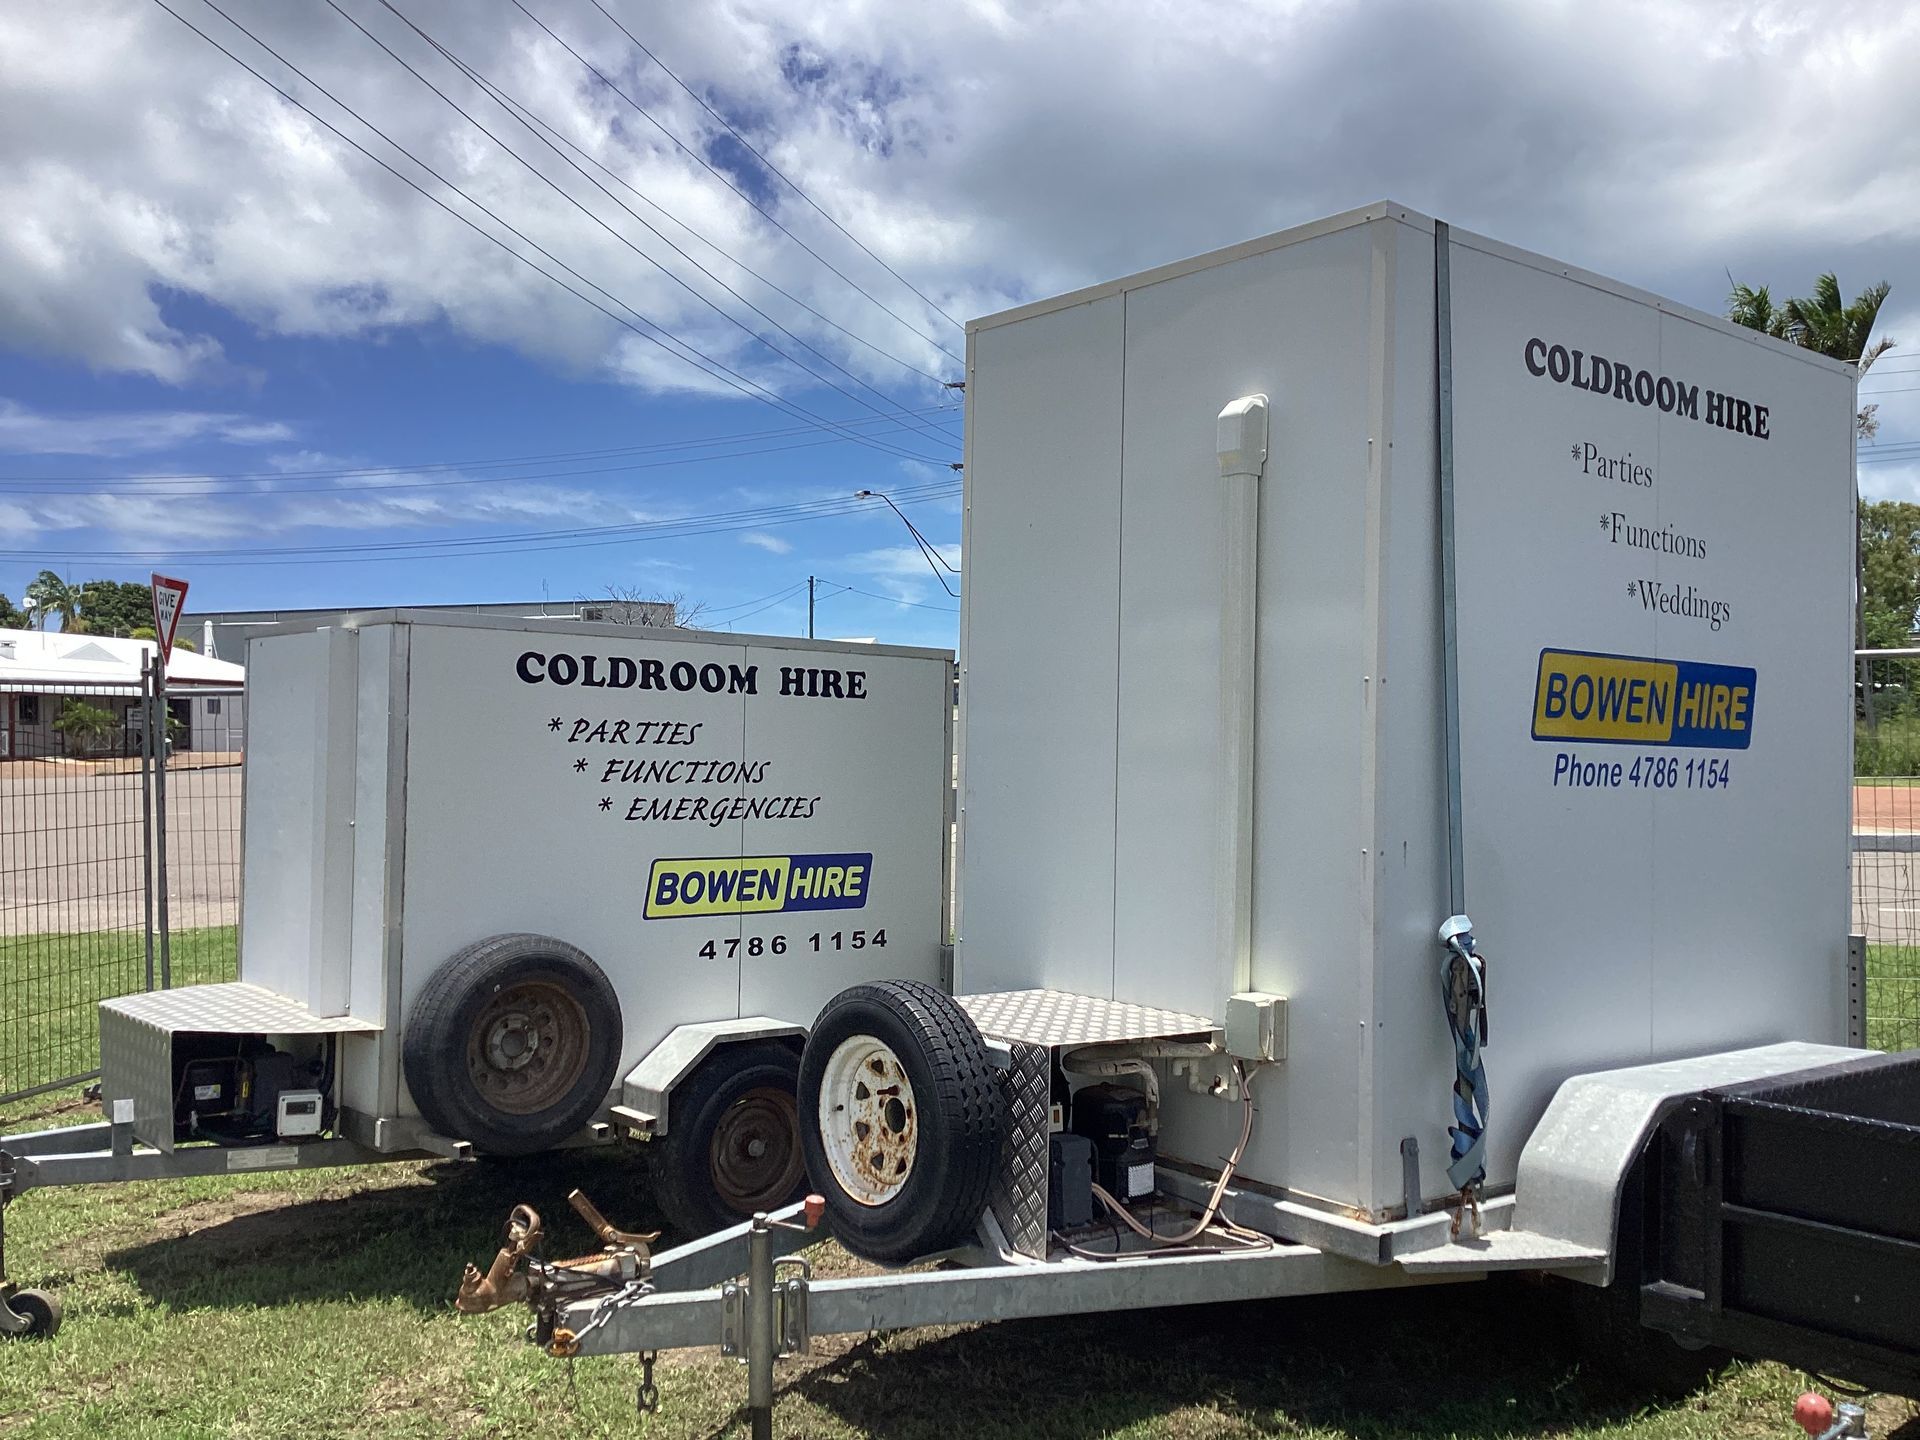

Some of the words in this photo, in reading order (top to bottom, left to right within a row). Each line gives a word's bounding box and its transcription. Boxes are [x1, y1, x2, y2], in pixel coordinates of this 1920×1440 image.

[1525, 337, 1699, 421] COLDROOM
[1705, 390, 1770, 440] HIRE
[159, 592, 175, 608] GIVE
[160, 610, 172, 621] WAY
[516, 651, 759, 693] COLDROOM
[779, 666, 868, 700] HIRE
[1545, 672, 1669, 725] BOWEN
[1678, 681, 1749, 731] HIRE
[600, 759, 771, 784] FUNCTIONS
[1553, 752, 1623, 788] Phone
[1629, 756, 1678, 788] 4786
[1684, 759, 1730, 789] 1154
[625, 797, 822, 827] EMERGENCIES
[655, 868, 782, 906] BOWEN
[790, 865, 865, 899] HIRE
[699, 934, 787, 960] 4786
[808, 928, 888, 953] 1154
